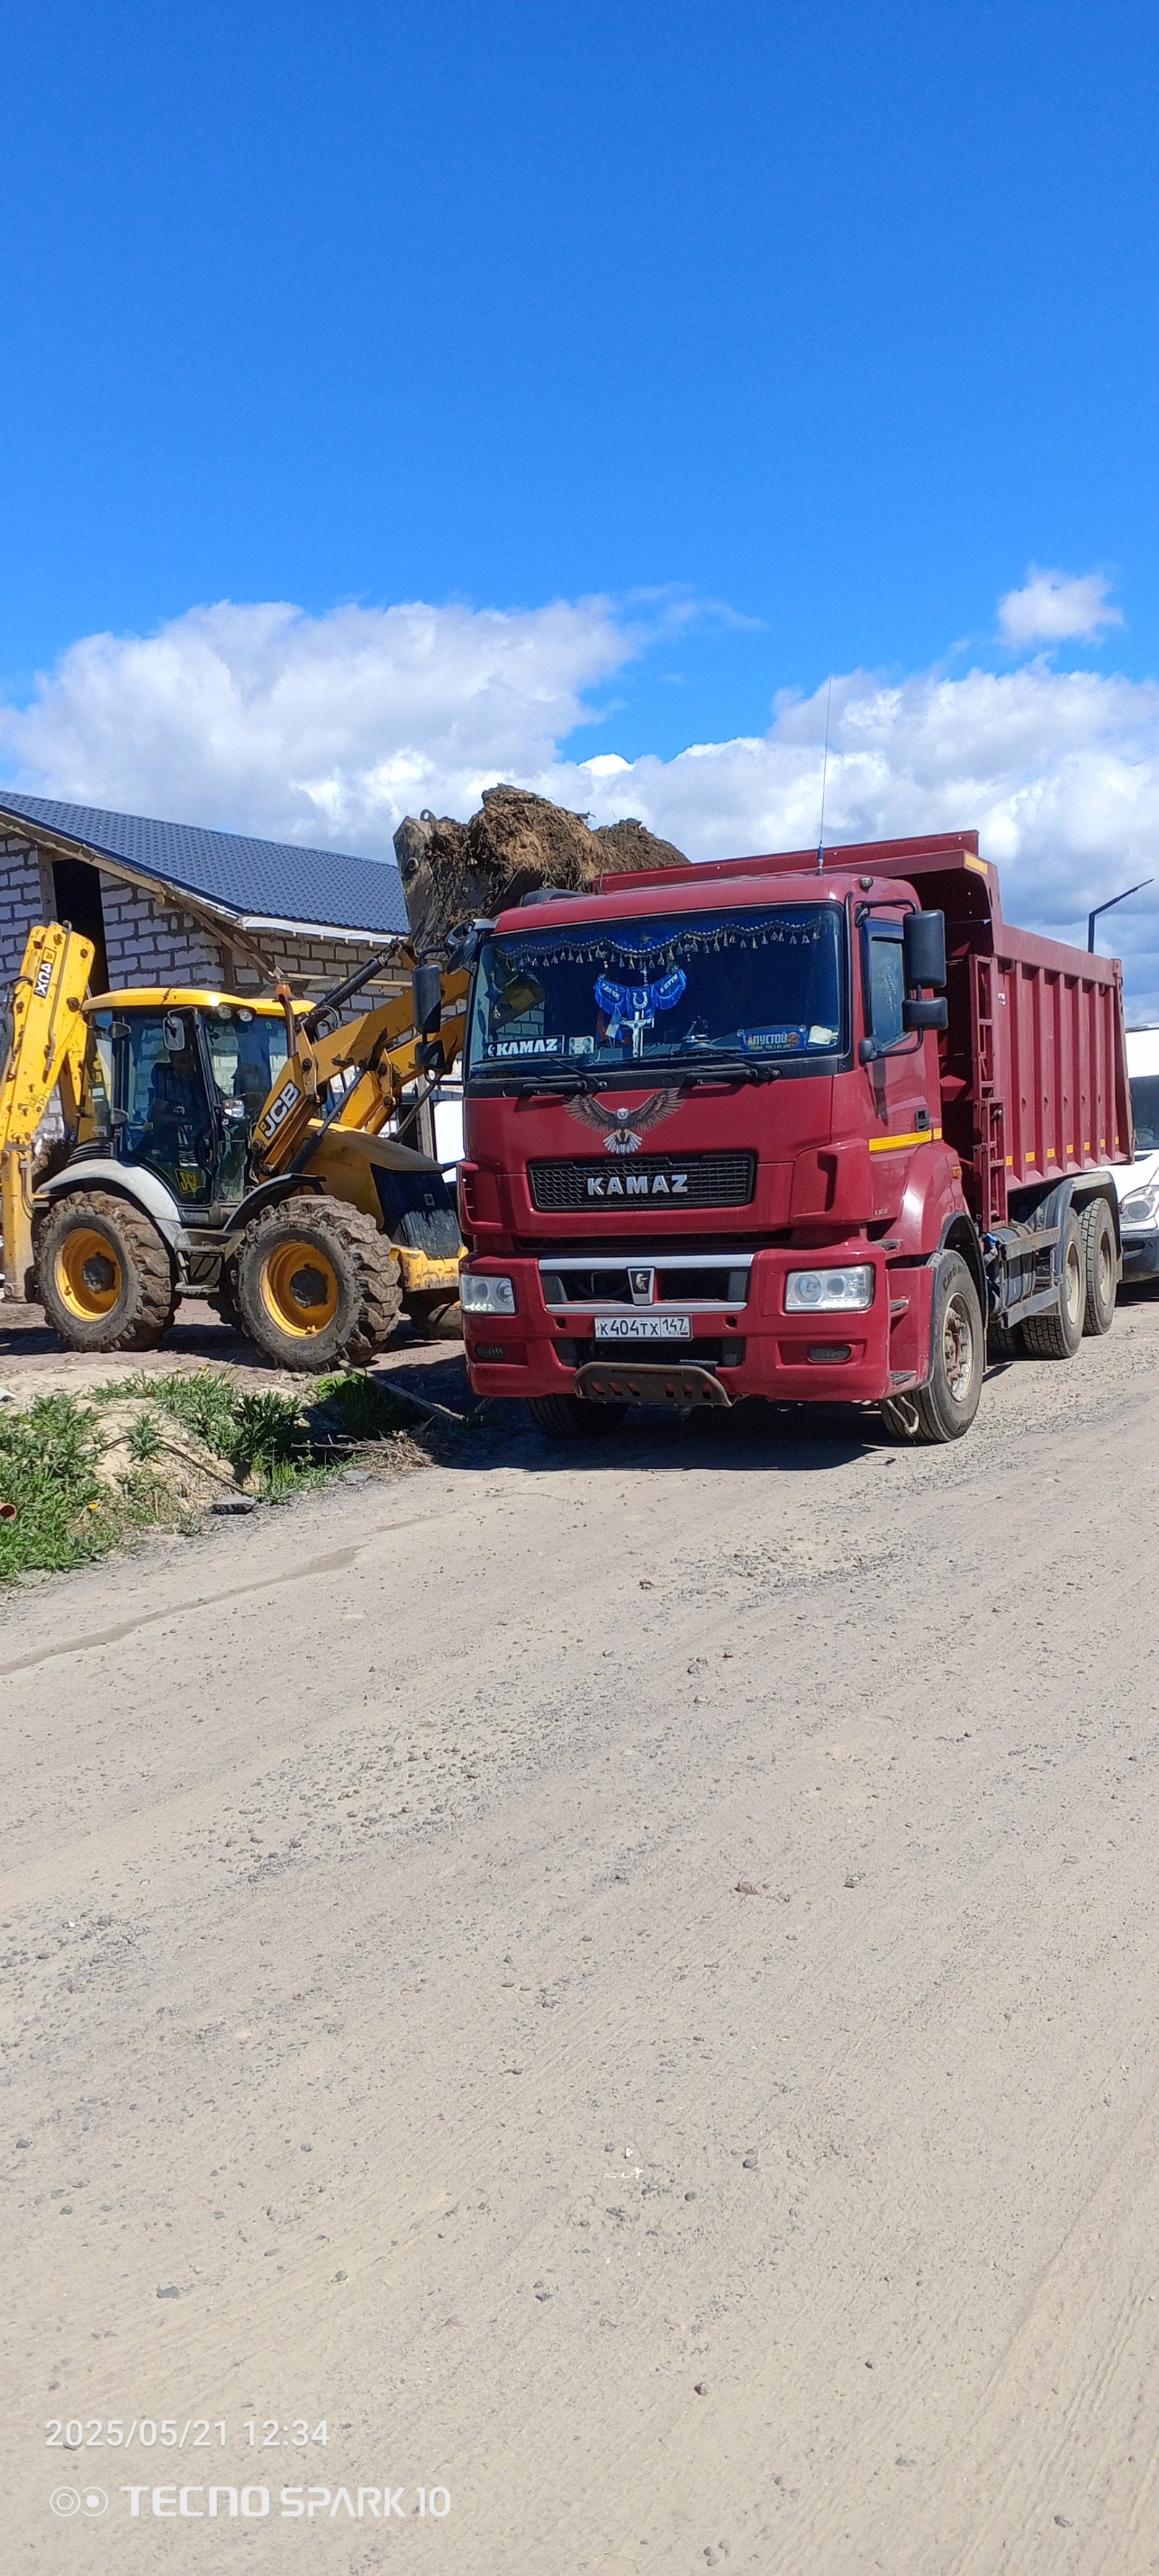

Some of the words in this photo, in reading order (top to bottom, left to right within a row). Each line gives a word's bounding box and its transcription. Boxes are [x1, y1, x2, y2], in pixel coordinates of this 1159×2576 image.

[35, 963, 52, 995] 4CX
[496, 1038, 558, 1056] KAMAZ
[753, 1032, 787, 1045] ПУСТОЙ
[264, 1082, 299, 1137] JCB
[587, 1174, 688, 1196] KAMAZ
[600, 1319, 659, 1336] К404ТХ
[662, 1318, 685, 1331] 147
